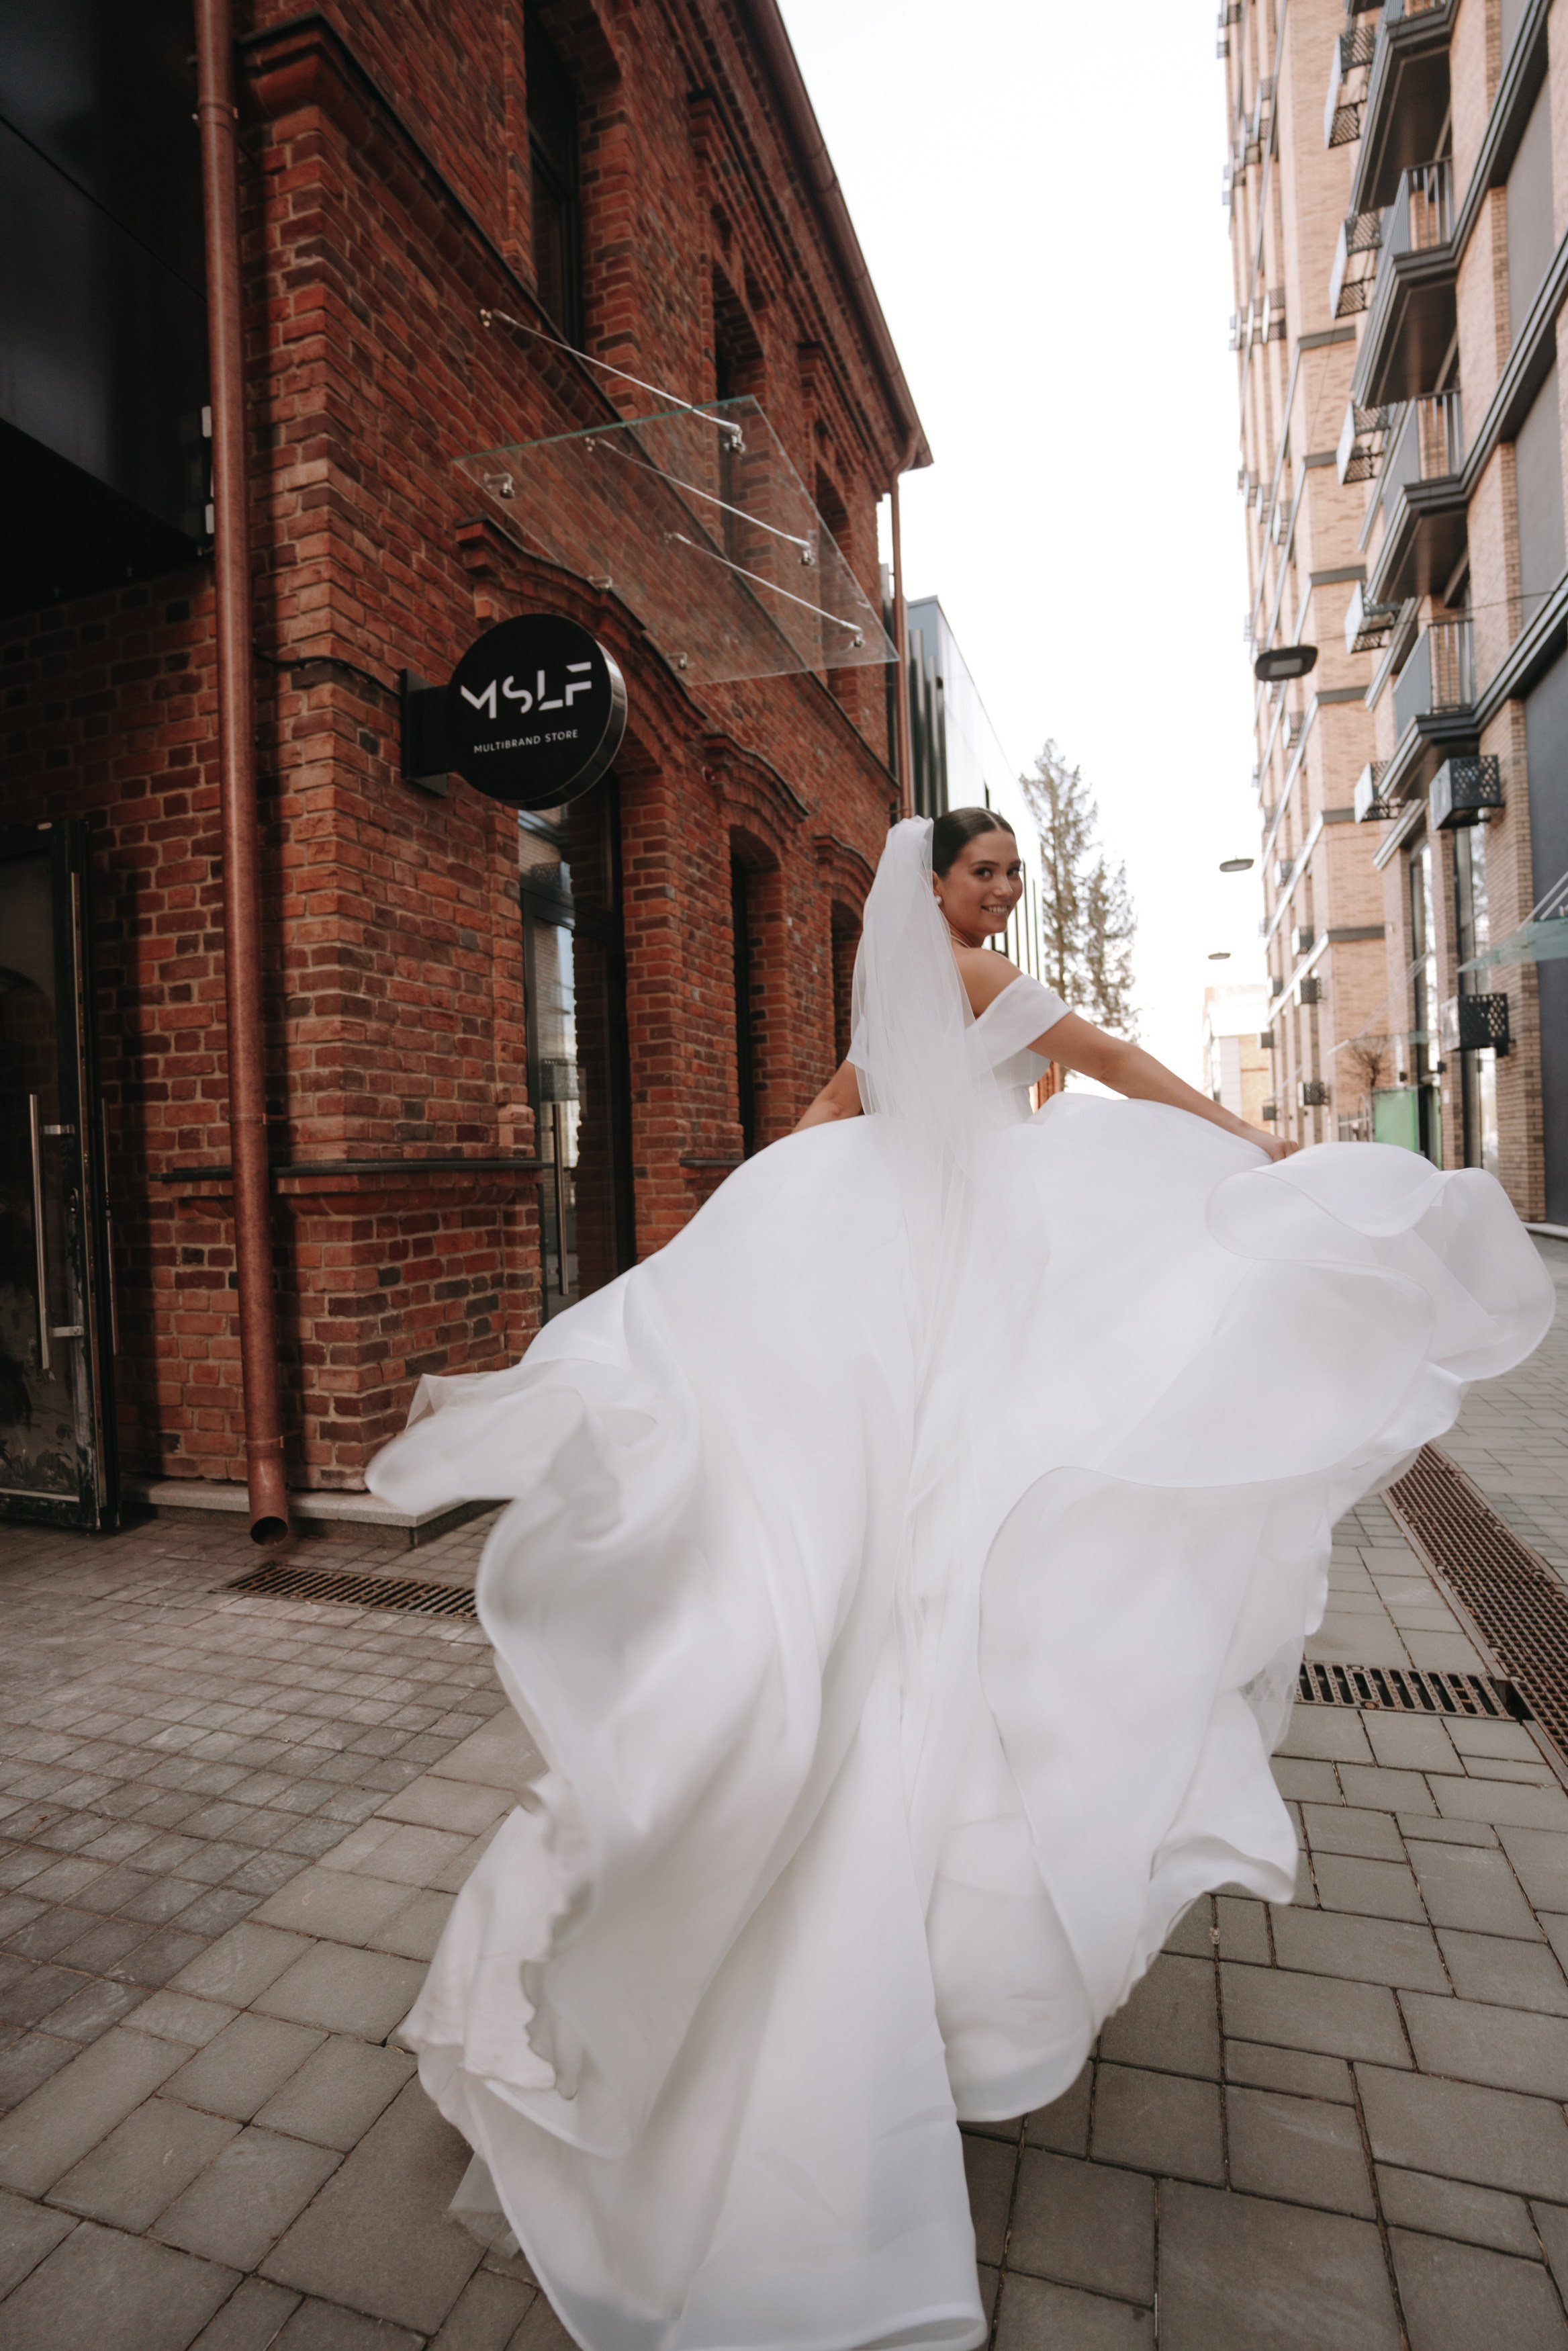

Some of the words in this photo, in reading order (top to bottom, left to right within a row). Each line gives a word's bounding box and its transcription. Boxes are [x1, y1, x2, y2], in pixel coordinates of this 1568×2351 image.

[460, 662, 592, 719] MSLF
[473, 736, 541, 753] MULTIBRAND
[545, 729, 579, 743] STORE
